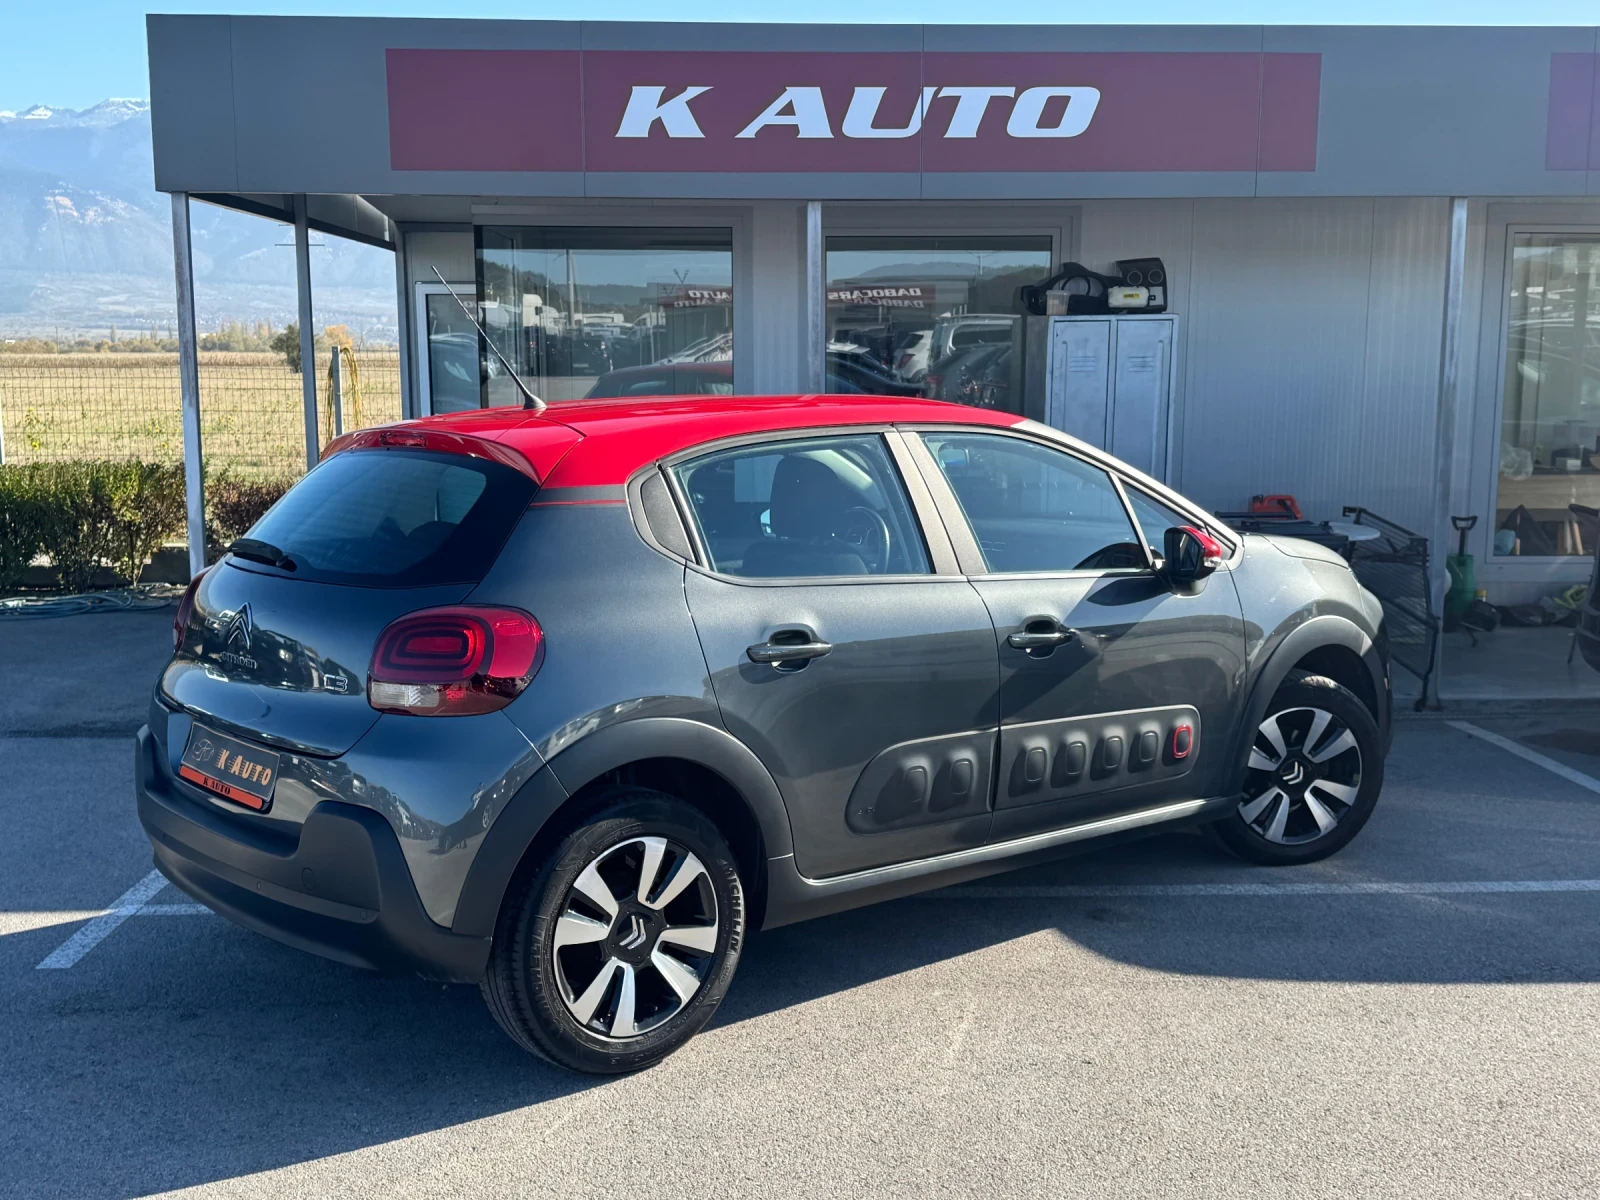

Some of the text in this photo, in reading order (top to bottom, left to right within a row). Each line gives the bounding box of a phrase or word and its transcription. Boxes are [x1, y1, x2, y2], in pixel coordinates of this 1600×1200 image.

[615, 86, 1100, 138] K AUTO
[324, 673, 348, 692] C3
[215, 749, 230, 770] K
[203, 776, 231, 795] K AUTO
[717, 859, 742, 955] MICHELIN
